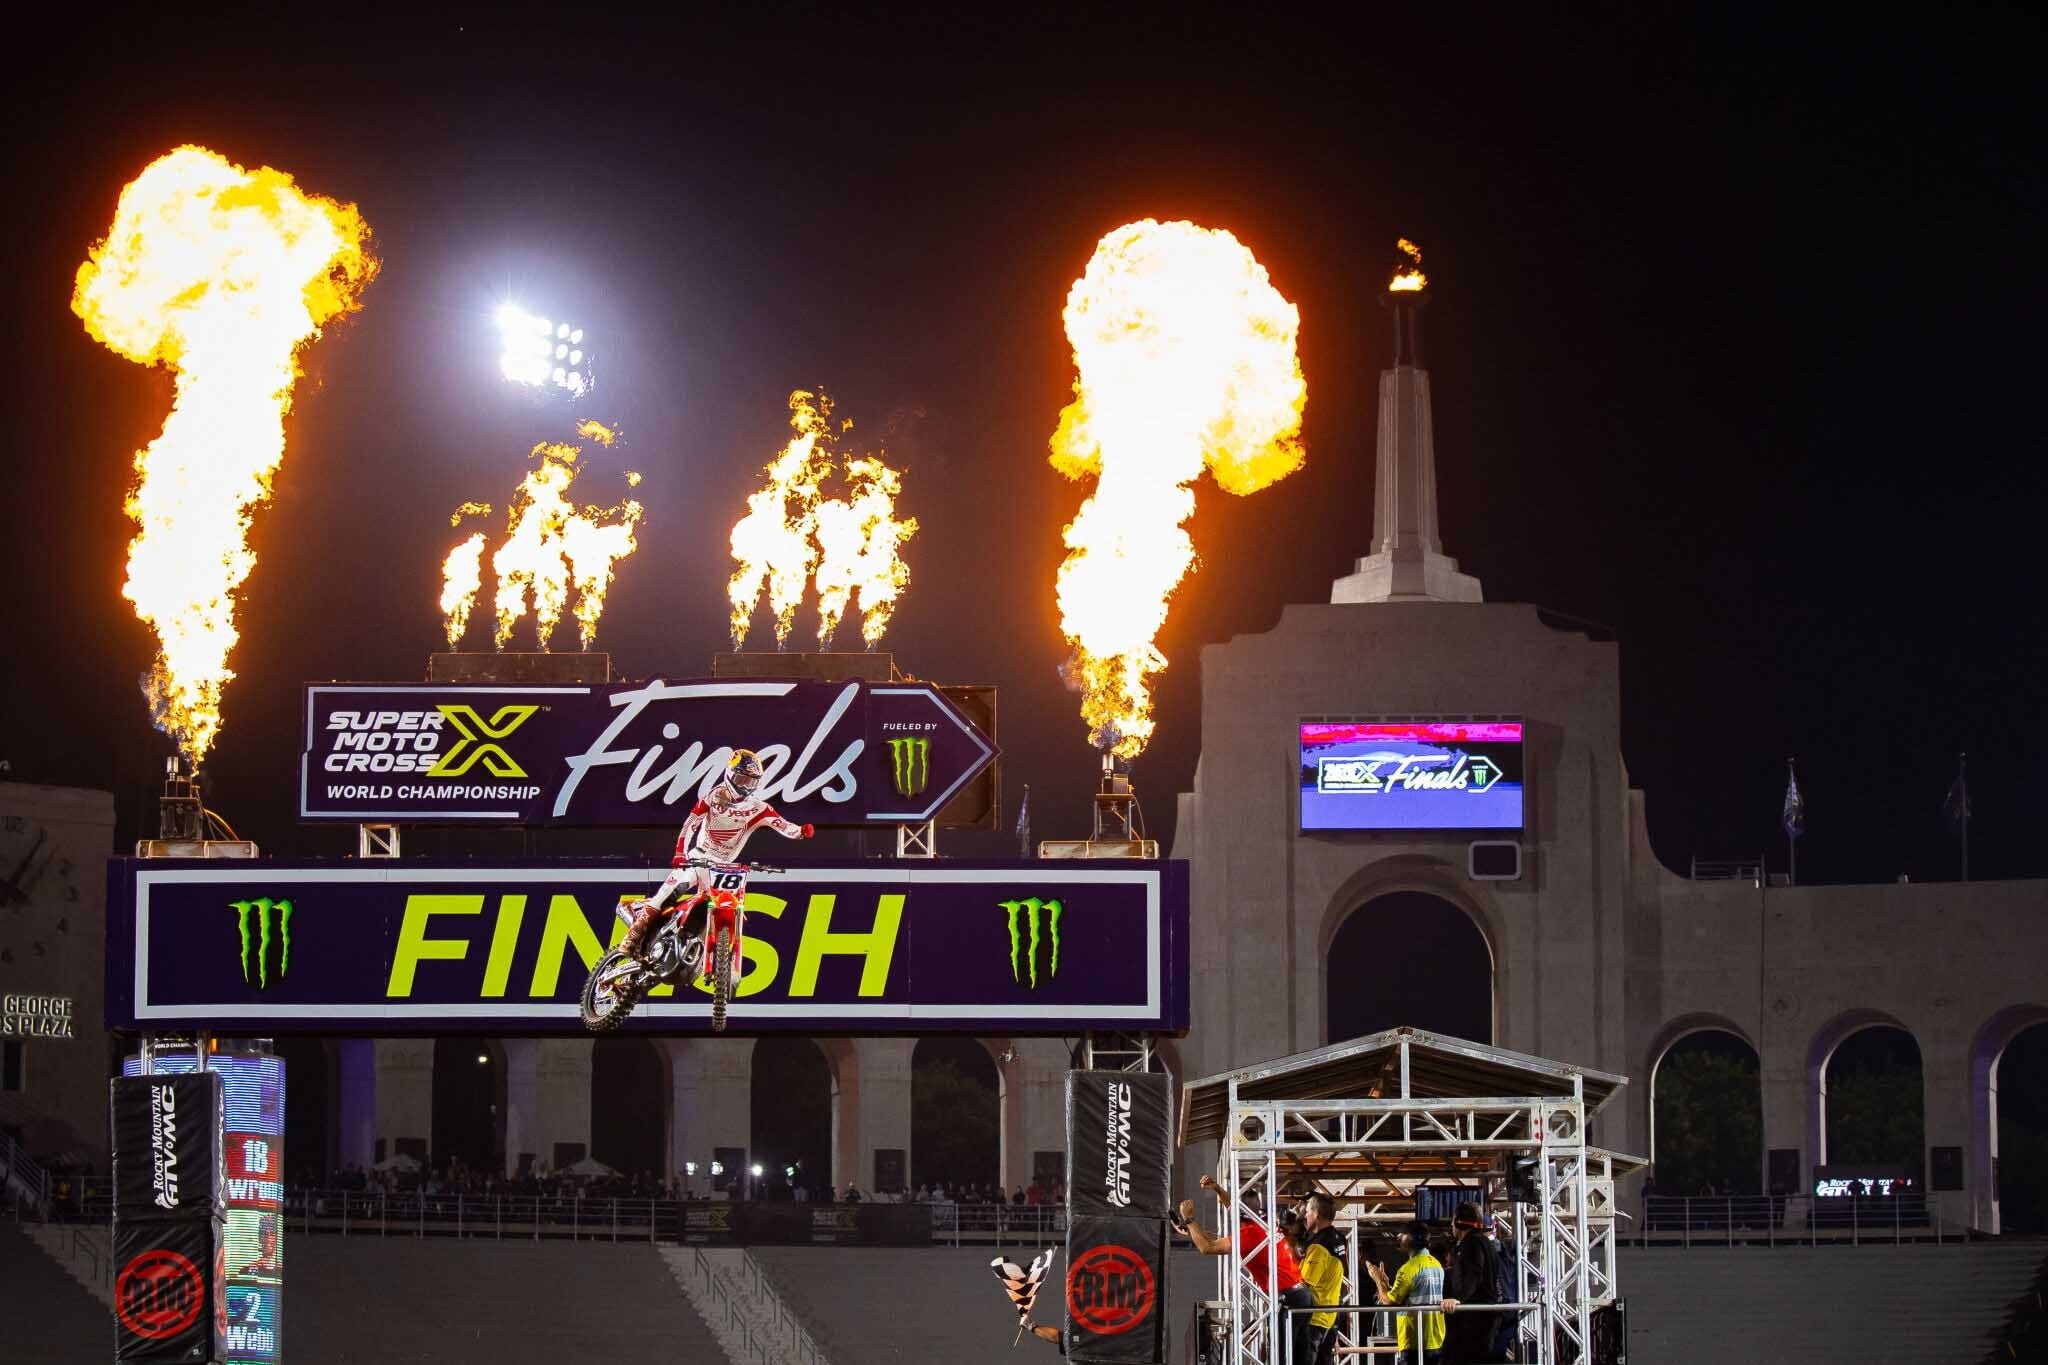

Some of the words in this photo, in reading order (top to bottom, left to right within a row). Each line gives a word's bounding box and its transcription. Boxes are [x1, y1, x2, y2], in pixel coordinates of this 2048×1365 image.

[325, 711, 446, 730] SUPER
[333, 732, 439, 751] MOTO
[323, 753, 441, 772] CROSS
[1384, 754, 1470, 794] Finals
[326, 785, 394, 799] WORLD
[397, 785, 541, 800] CHAMPIONSHIP
[713, 873, 743, 890] 18
[386, 893, 905, 998] FINSH
[4, 994, 73, 1018] GEORGE
[19, 1016, 74, 1038] PLAZA
[151, 1085, 163, 1149] MOUNTAIN
[1106, 1082, 1118, 1147] MOUNTAIN
[152, 1151, 164, 1190] ROCKY
[241, 1139, 269, 1174] 18
[1105, 1147, 1117, 1189] ROCKY
[245, 1293, 261, 1322] 2
